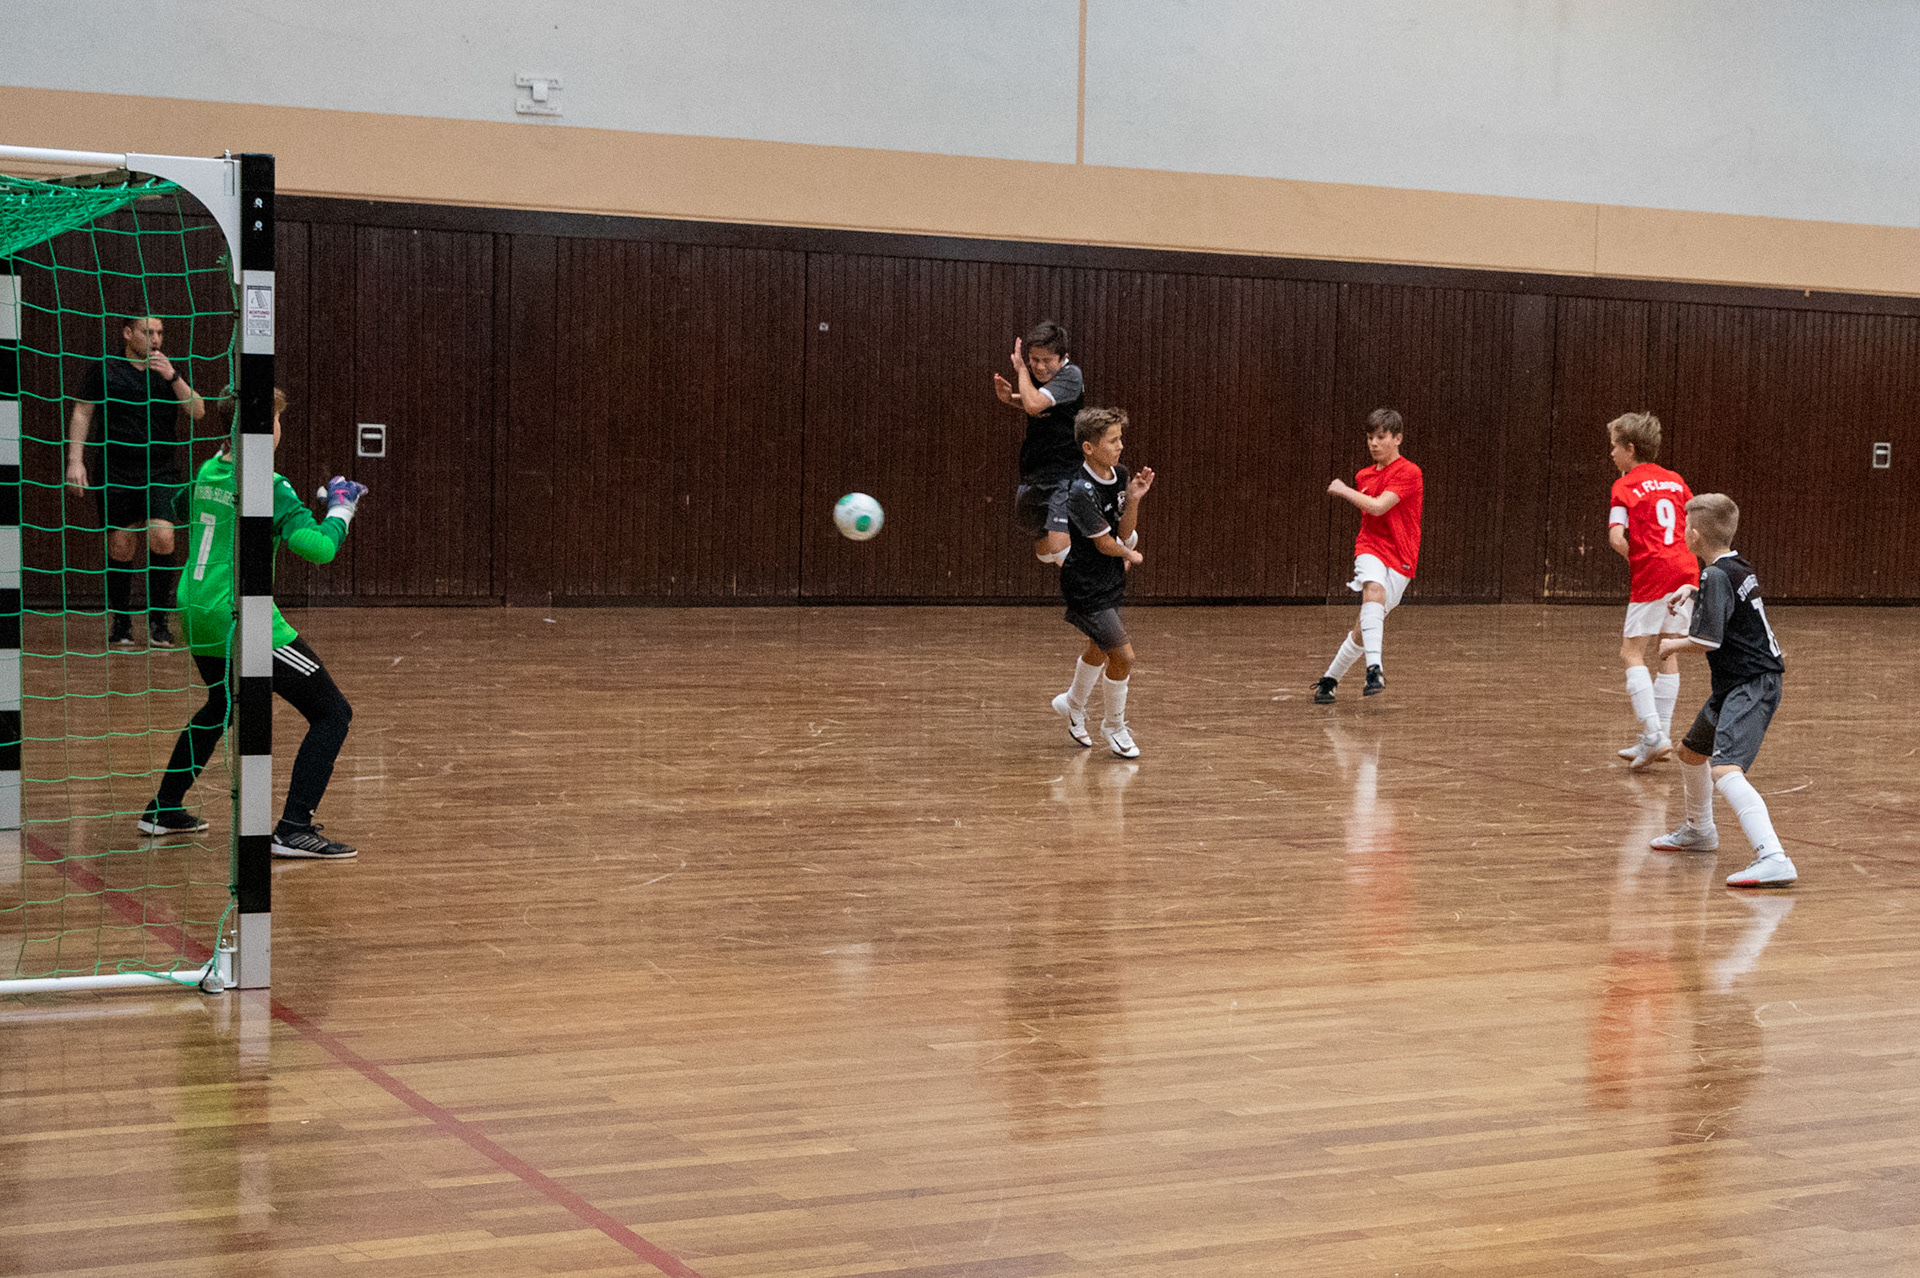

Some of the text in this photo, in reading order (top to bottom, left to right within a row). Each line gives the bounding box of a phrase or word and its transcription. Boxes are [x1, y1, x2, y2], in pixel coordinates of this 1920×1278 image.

[1632, 488, 1646, 498] 1.
[1641, 480, 1656, 493] FC
[1656, 498, 1676, 546] 9
